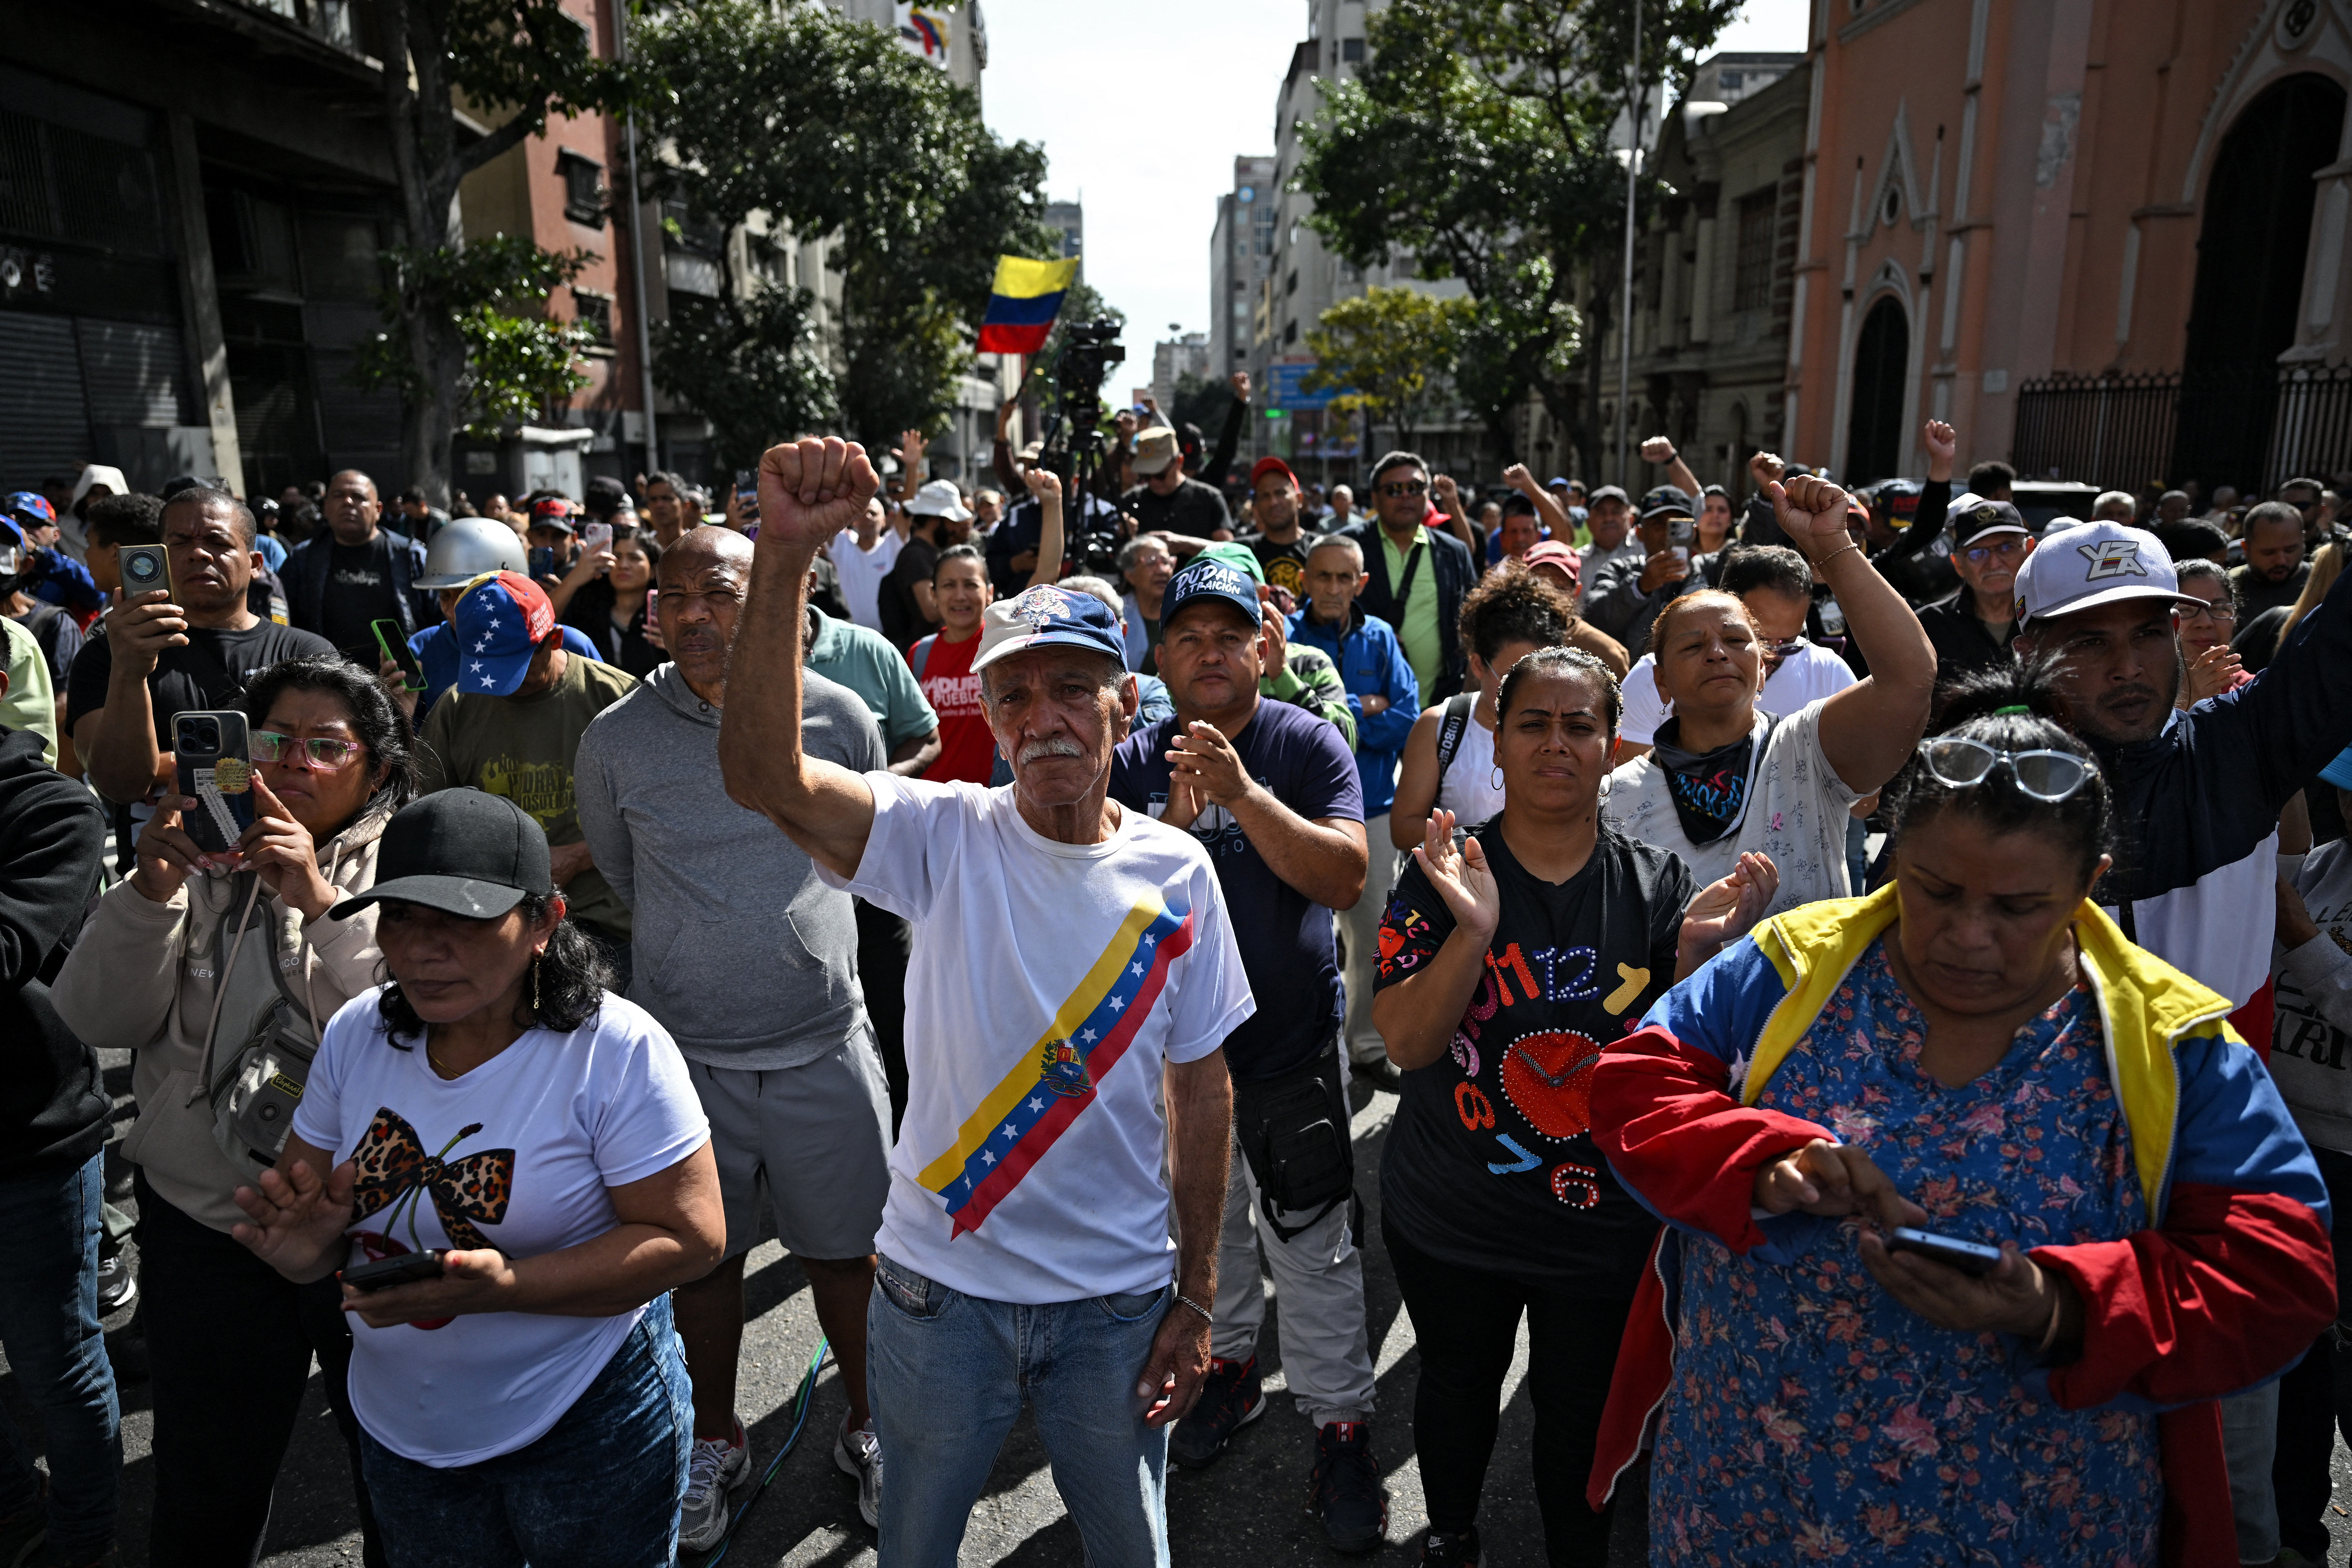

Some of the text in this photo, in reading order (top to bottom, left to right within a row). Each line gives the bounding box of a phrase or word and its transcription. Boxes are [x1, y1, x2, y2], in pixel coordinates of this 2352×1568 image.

[1175, 580, 1241, 601] ES TRAICIÓN
[1176, 565, 1241, 592] DUDAR
[1484, 943, 1540, 1007] 11
[1532, 945, 1601, 1003] 12
[275, 1076, 300, 1094] Elephant
[1454, 1081, 1496, 1131] 8
[1550, 1162, 1600, 1210] 6
[885, 1274, 901, 1291] Lee
[1430, 1535, 1442, 1544] NIKE
